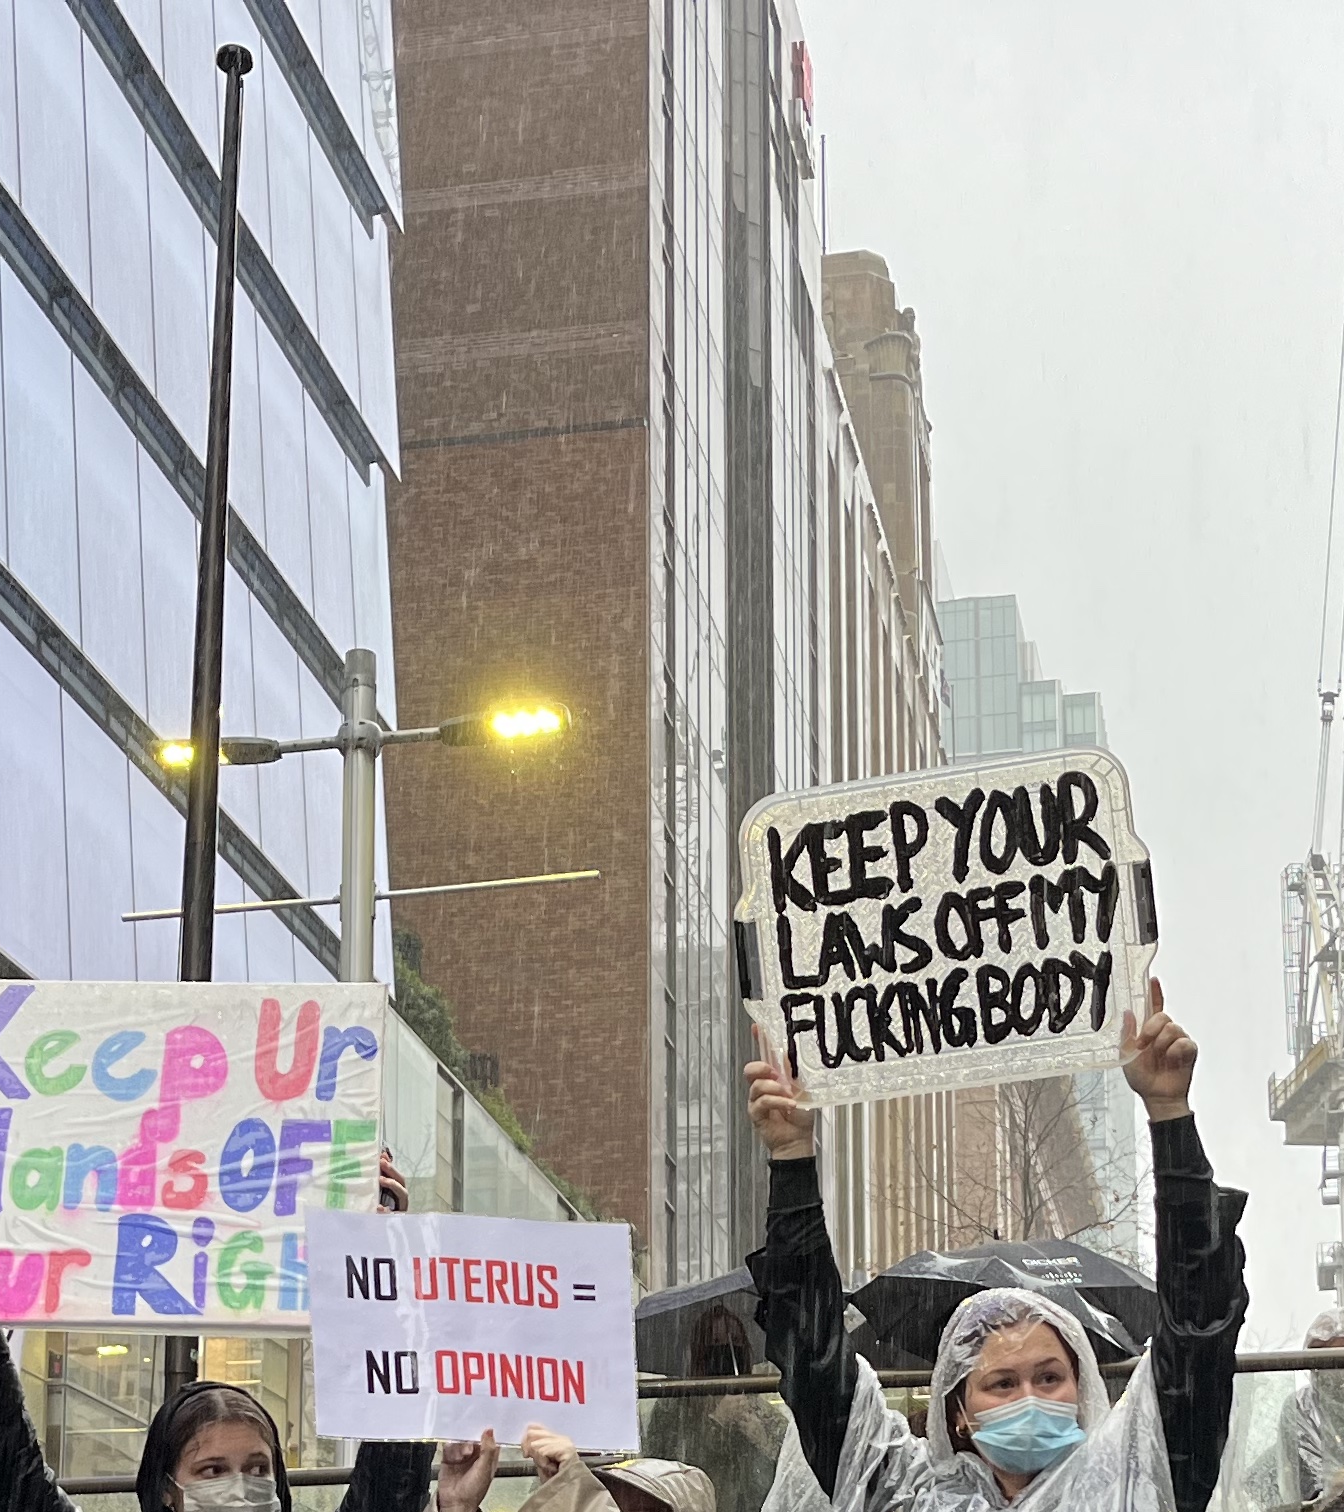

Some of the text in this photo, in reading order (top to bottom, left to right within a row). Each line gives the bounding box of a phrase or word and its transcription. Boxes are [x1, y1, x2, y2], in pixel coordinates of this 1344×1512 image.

[767, 771, 1111, 914] KEEP YOUR
[777, 860, 1120, 990] LAWS OFF MY
[780, 950, 1114, 1078] FUCKING BODY
[218, 1116, 377, 1217] OFF
[345, 1255, 398, 1301] NO
[413, 1256, 560, 1309] UTERUS
[365, 1349, 586, 1405] NO OPINION
